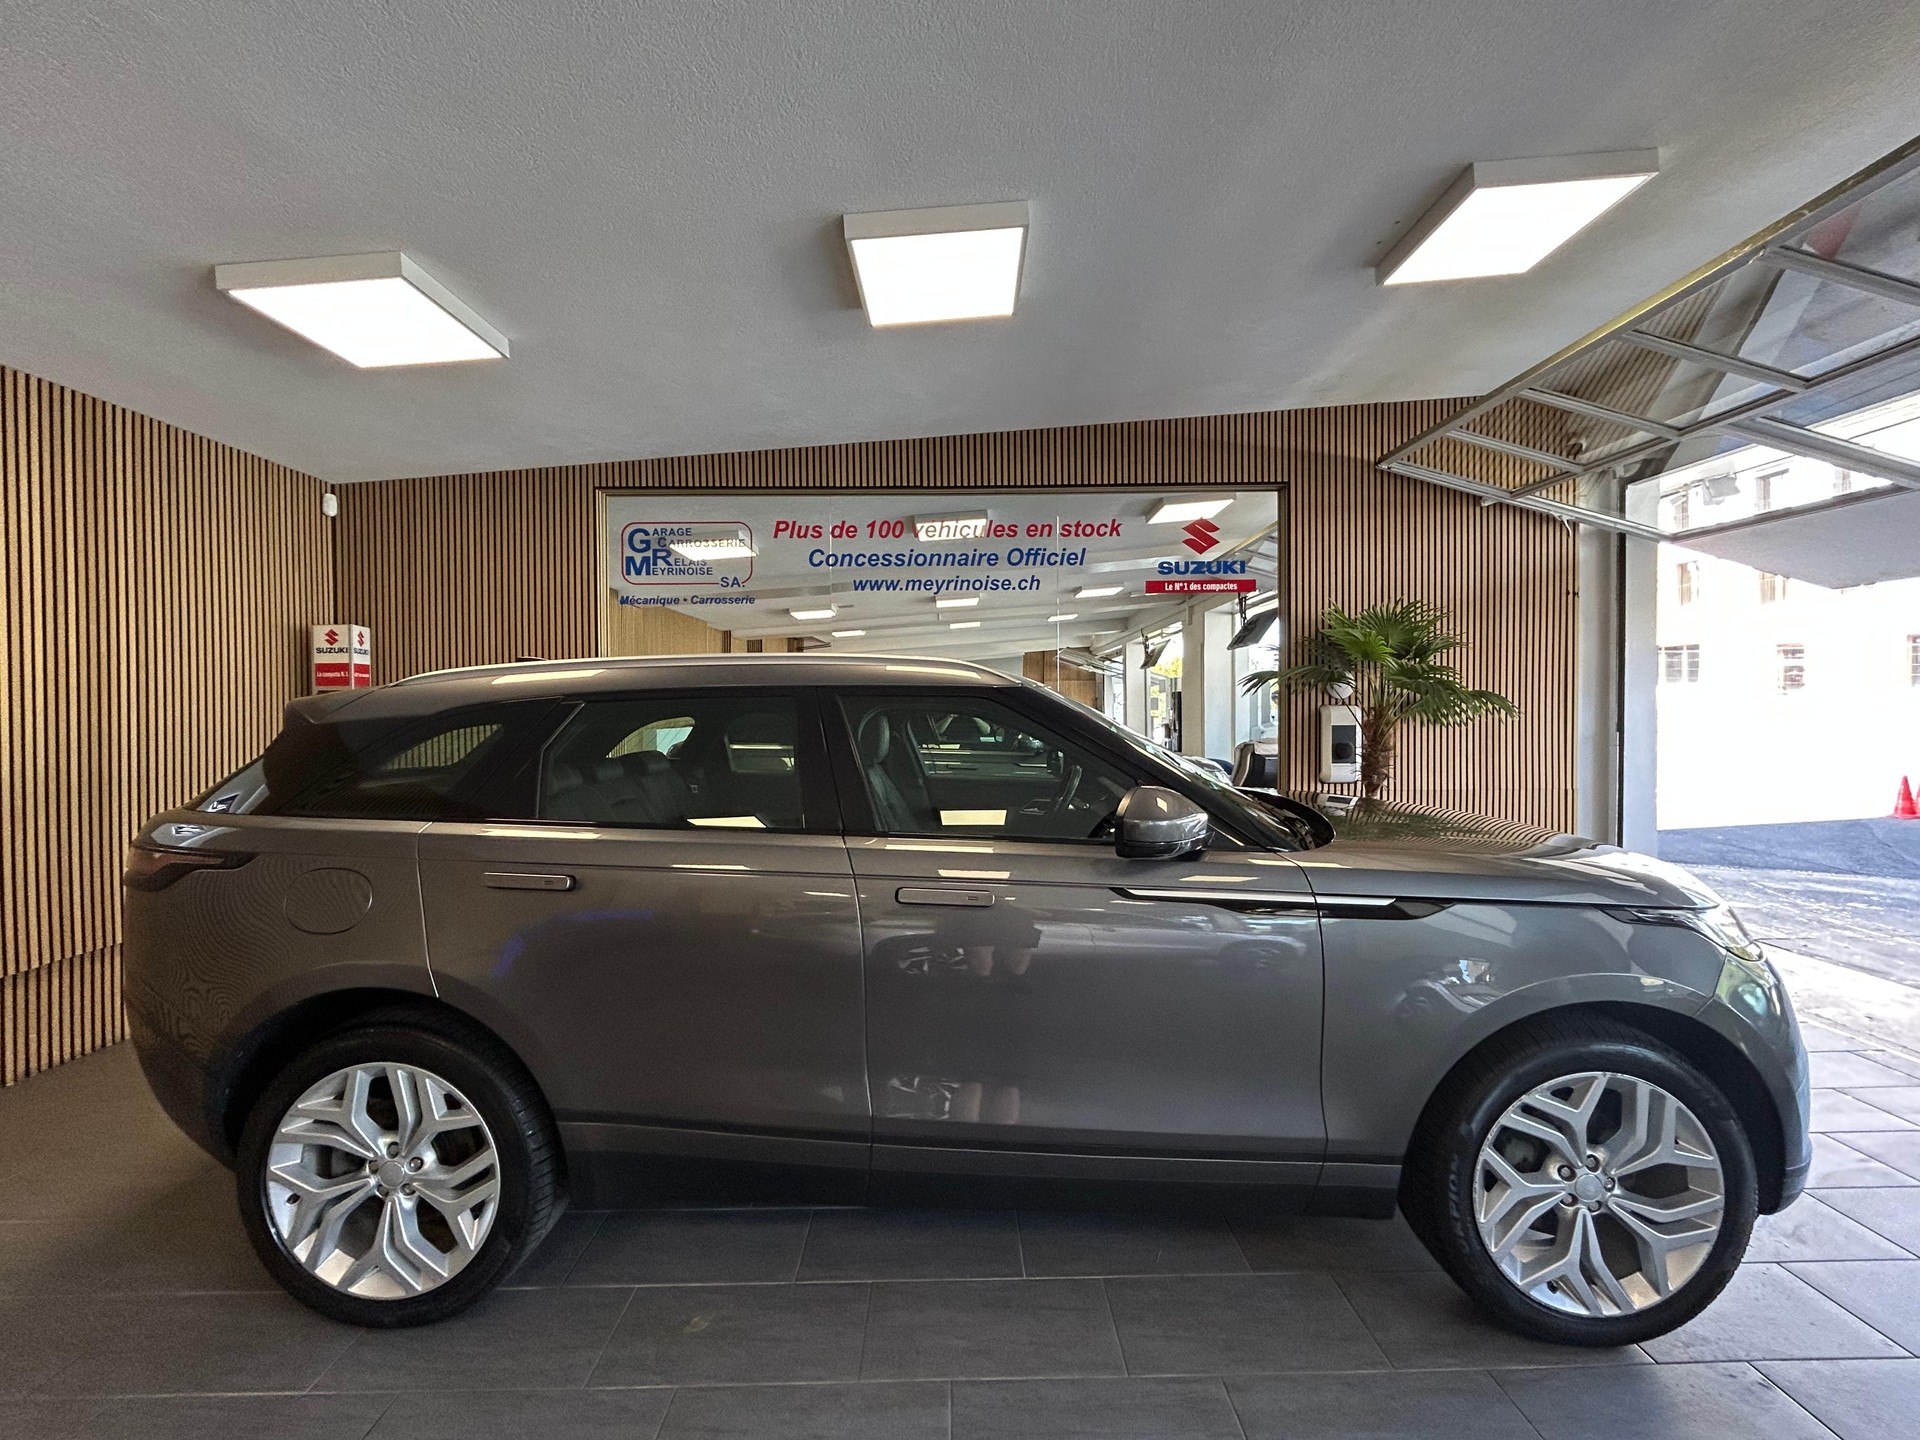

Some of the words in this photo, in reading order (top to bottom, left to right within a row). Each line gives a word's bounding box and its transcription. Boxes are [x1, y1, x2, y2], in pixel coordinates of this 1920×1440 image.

[773, 520, 823, 539] Plus
[831, 520, 858, 539] de
[866, 519, 905, 539] 100
[912, 518, 1019, 539] véhicules
[1025, 522, 1054, 539] en
[1060, 518, 1123, 538] stock
[627, 527, 692, 553] GARAGE
[657, 537, 746, 549] CARROSSERIE
[625, 555, 714, 577] MEYRINOISE
[651, 548, 707, 567] RELAIS
[808, 548, 999, 568] Concessionnaire
[1006, 547, 1087, 567] Officiel
[1157, 560, 1246, 576] SUZUKI
[720, 576, 746, 588] SA.
[853, 574, 1041, 595] www.meyrinoise.ch
[1164, 582, 1173, 591] Le
[1189, 582, 1201, 591] des
[1202, 582, 1238, 592] compactes
[619, 595, 680, 607] Mécanique
[690, 594, 756, 606] Carrosserie
